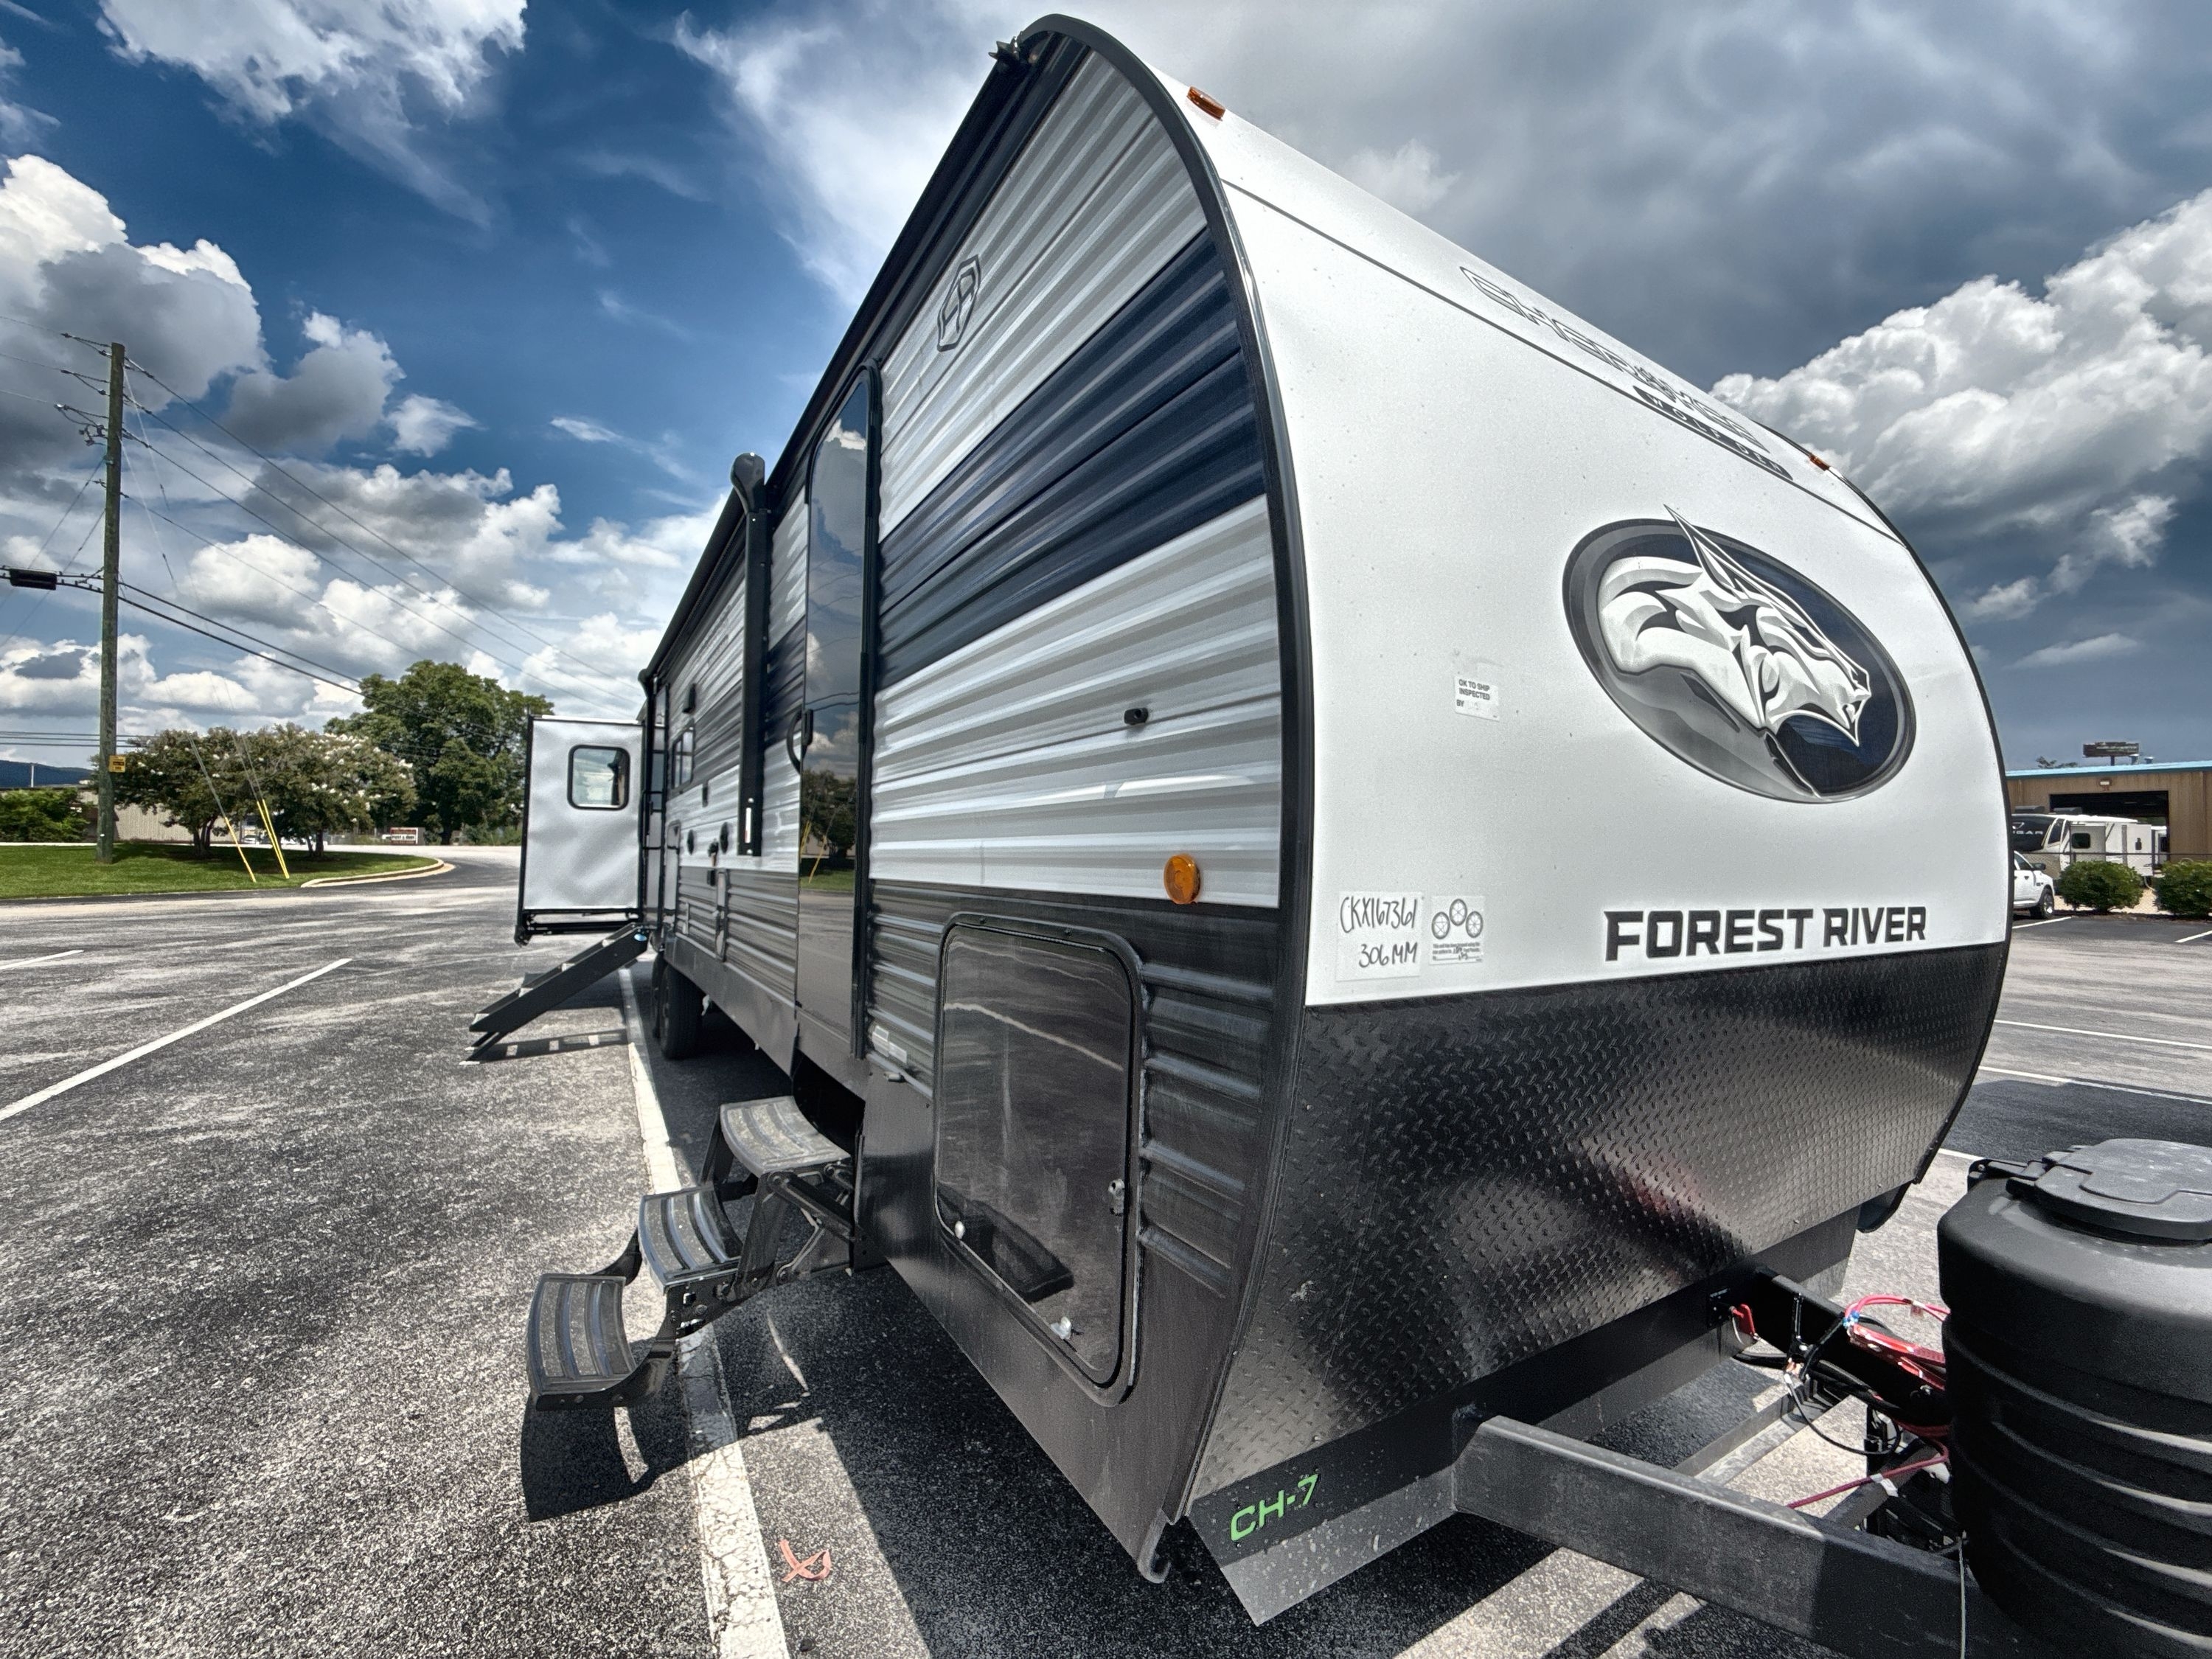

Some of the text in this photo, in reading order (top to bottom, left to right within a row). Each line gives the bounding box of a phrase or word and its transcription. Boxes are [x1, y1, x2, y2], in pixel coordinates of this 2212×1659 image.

[1646, 393, 1721, 439] WOLF
[1458, 678, 1490, 691] OK TO SHIP
[1459, 687, 1490, 700] INSPECTED
[1340, 896, 1417, 933] CKX167361
[1604, 906, 1926, 962] FOREST RIVER
[1231, 1473, 1318, 1541] CH-7
